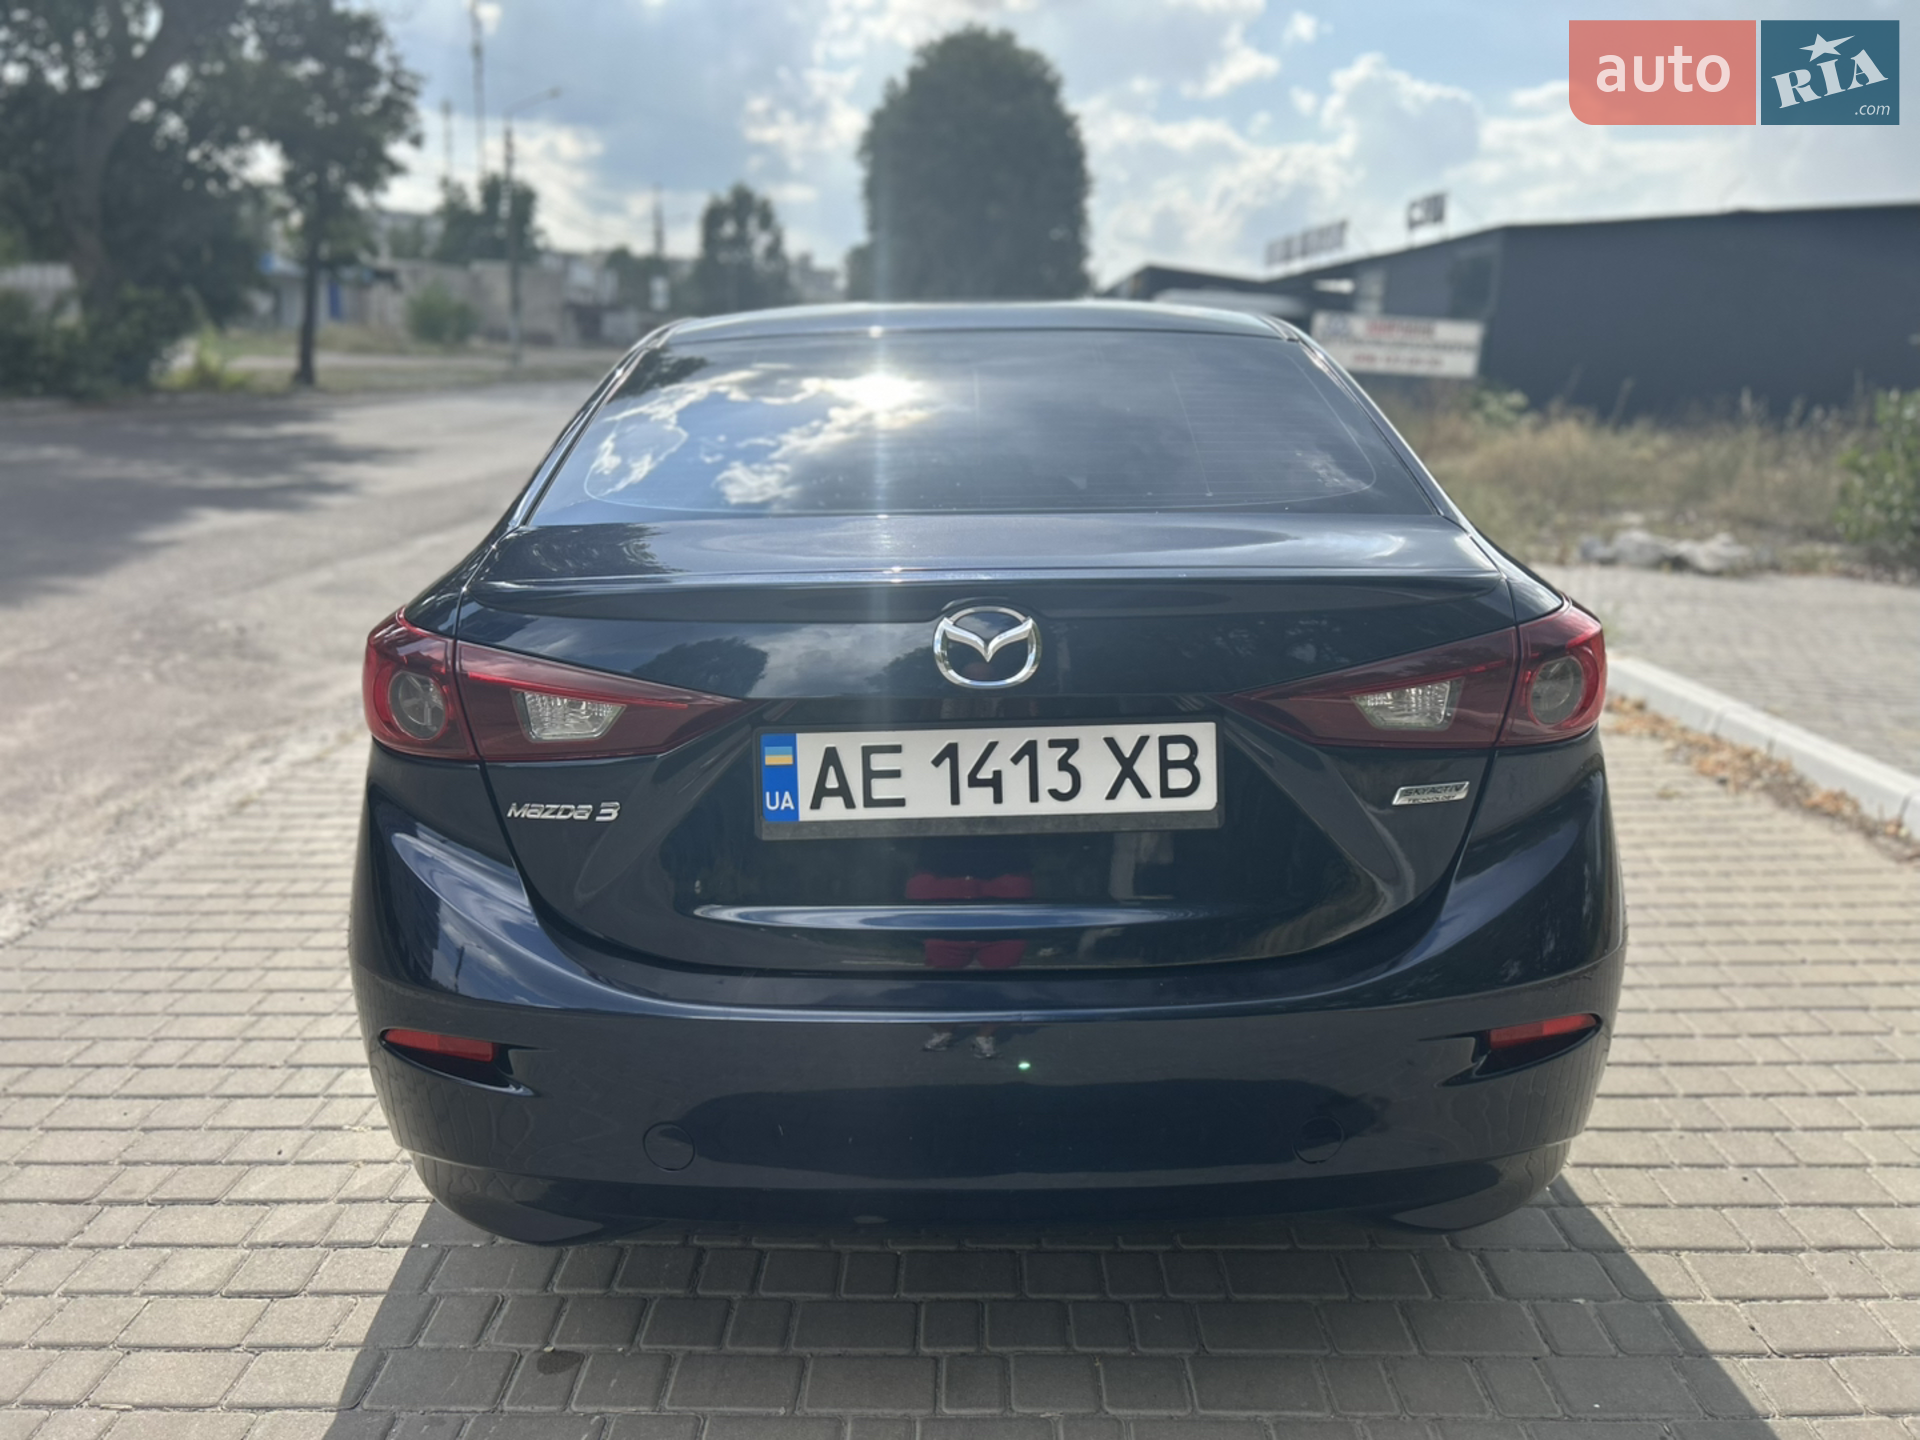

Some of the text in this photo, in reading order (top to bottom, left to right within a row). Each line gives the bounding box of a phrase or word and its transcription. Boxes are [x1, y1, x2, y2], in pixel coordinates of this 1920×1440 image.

[809, 733, 1202, 810] AE 1413 XB
[765, 791, 795, 810] UA
[1402, 784, 1462, 797] SKYACTIV
[595, 801, 621, 822] 3
